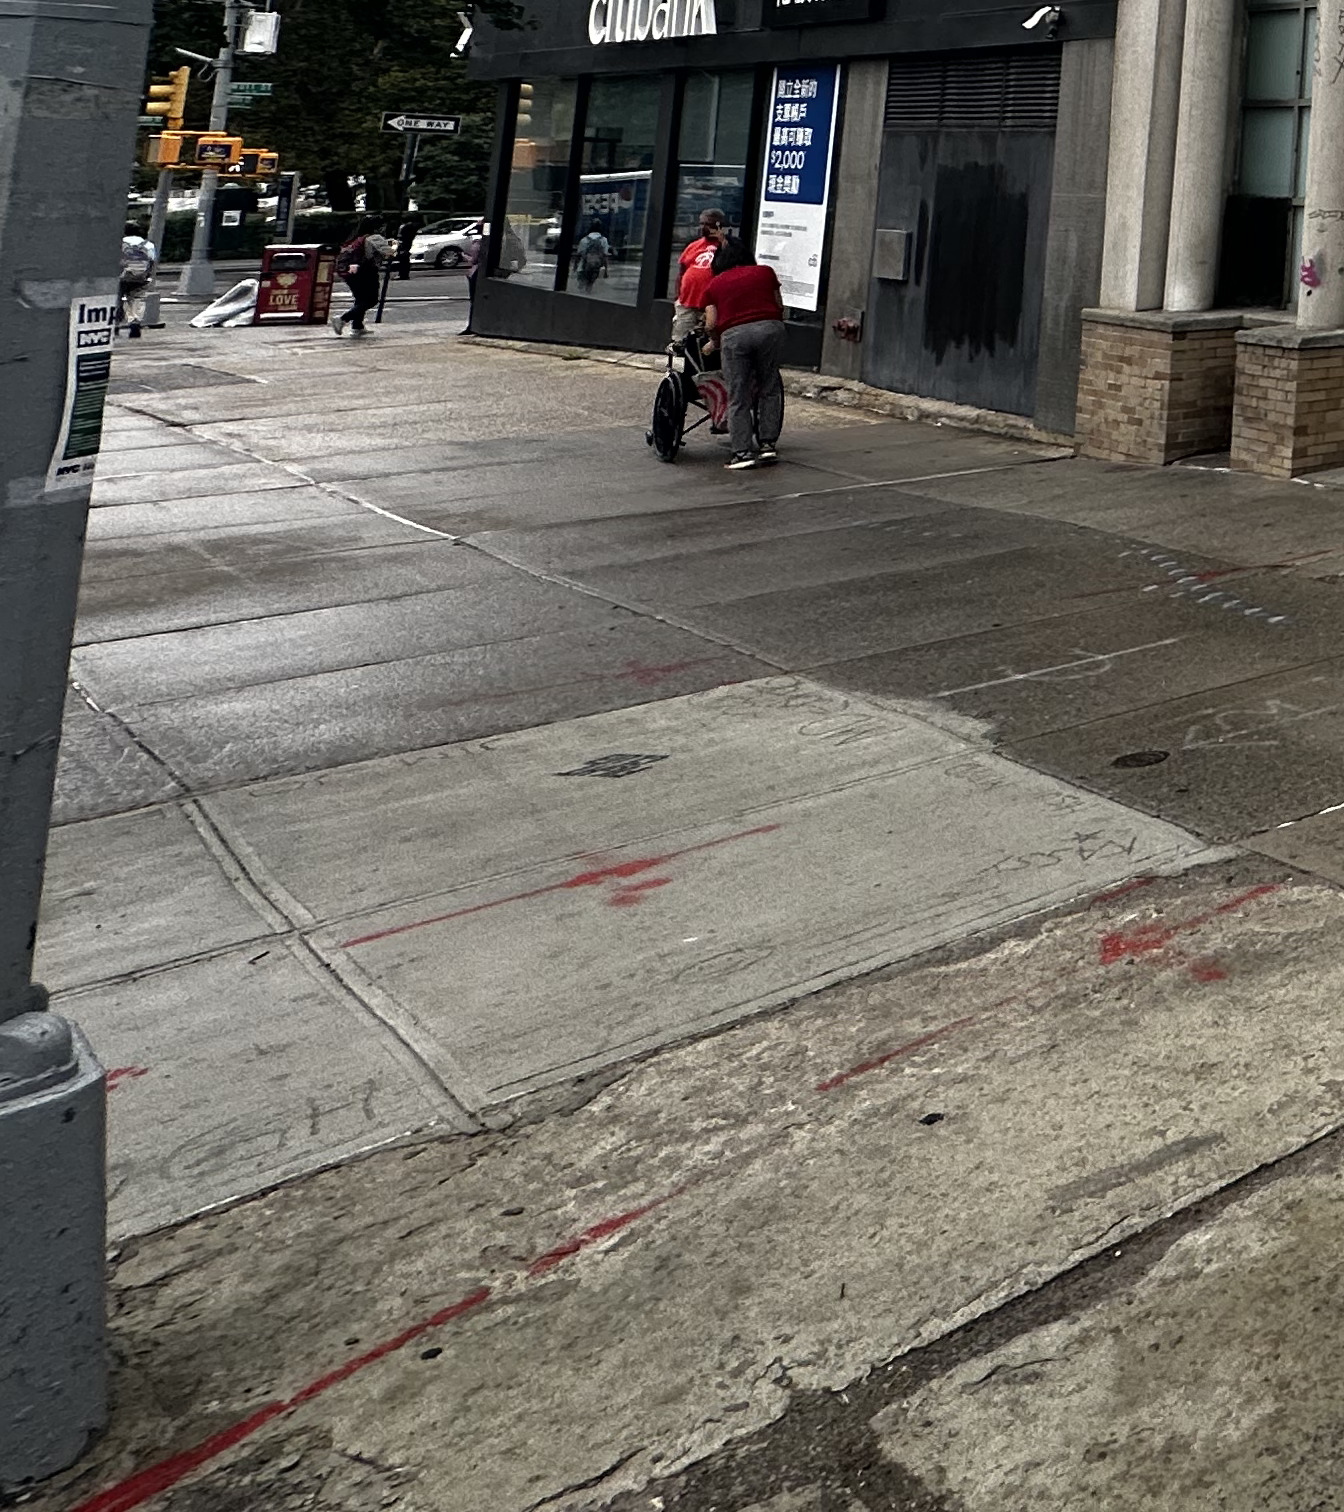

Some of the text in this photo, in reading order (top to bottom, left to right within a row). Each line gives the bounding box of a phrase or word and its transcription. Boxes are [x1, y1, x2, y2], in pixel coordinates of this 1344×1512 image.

[397, 118, 449, 129] ONE WAY
[268, 294, 298, 305] LOVE
